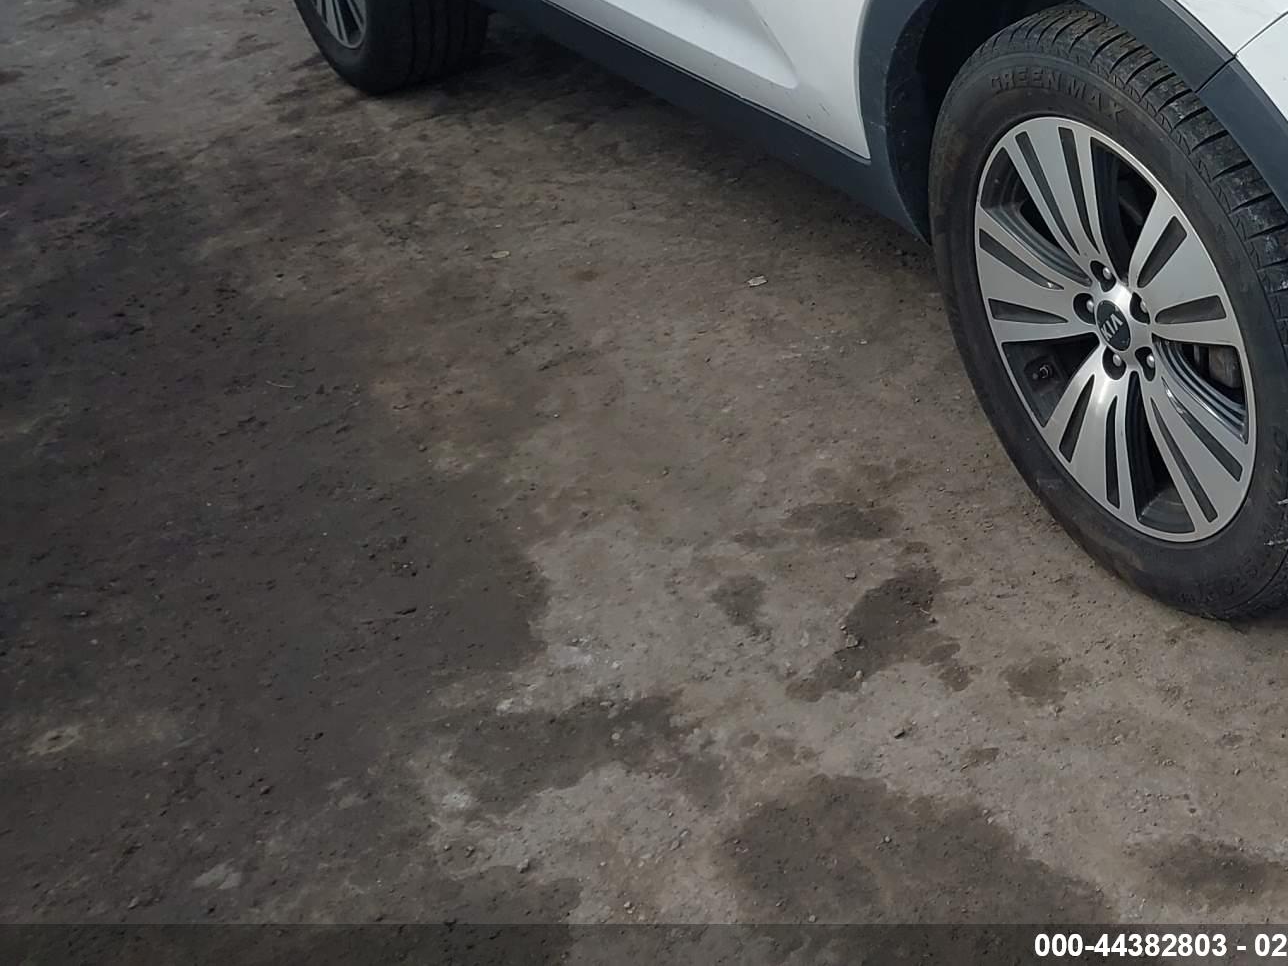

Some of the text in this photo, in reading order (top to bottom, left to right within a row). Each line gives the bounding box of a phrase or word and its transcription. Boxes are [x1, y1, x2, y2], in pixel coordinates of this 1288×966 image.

[991, 66, 1129, 124] GREEN MAX
[1100, 313, 1124, 342] KIA
